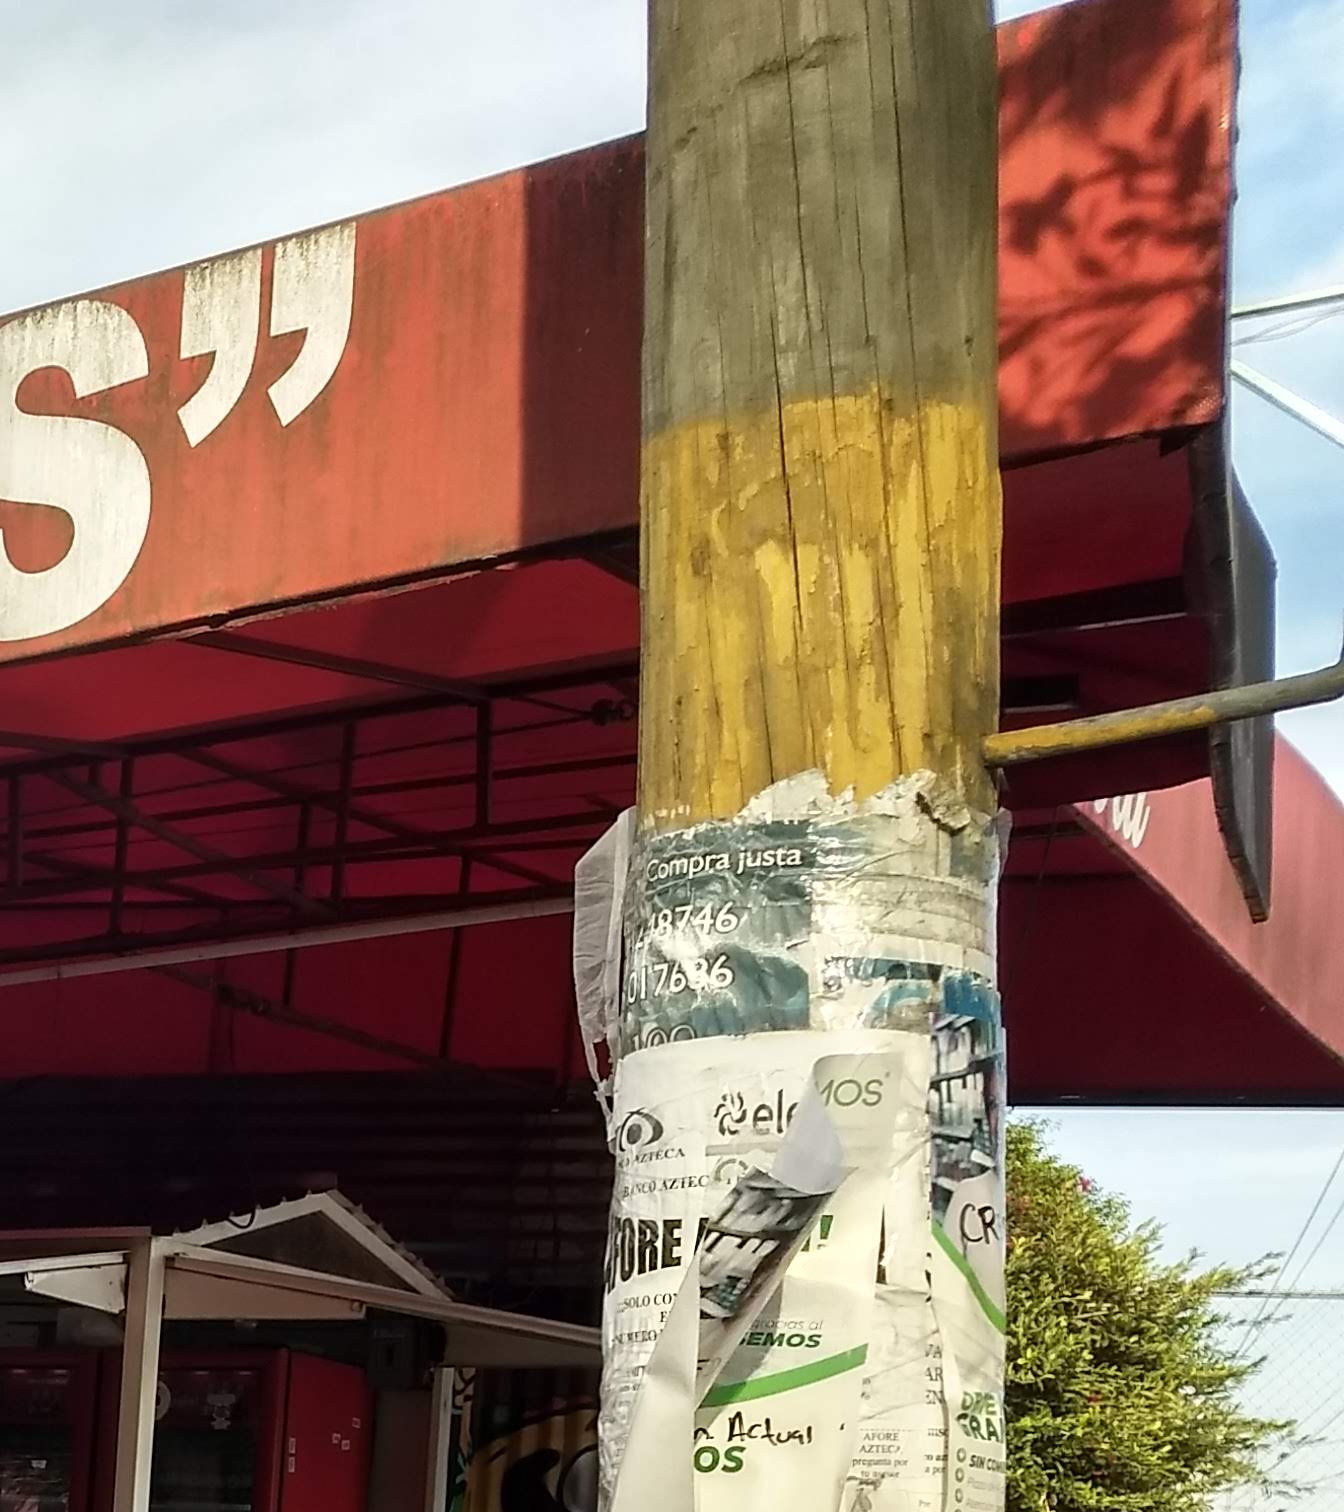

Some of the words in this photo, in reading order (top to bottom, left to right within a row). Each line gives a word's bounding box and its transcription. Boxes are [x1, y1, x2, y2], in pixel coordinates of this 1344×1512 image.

[646, 853, 730, 882] Compra
[736, 848, 802, 875] justa
[660, 1175, 710, 1193] AZTEC
[863, 1432, 900, 1441] AFORE
